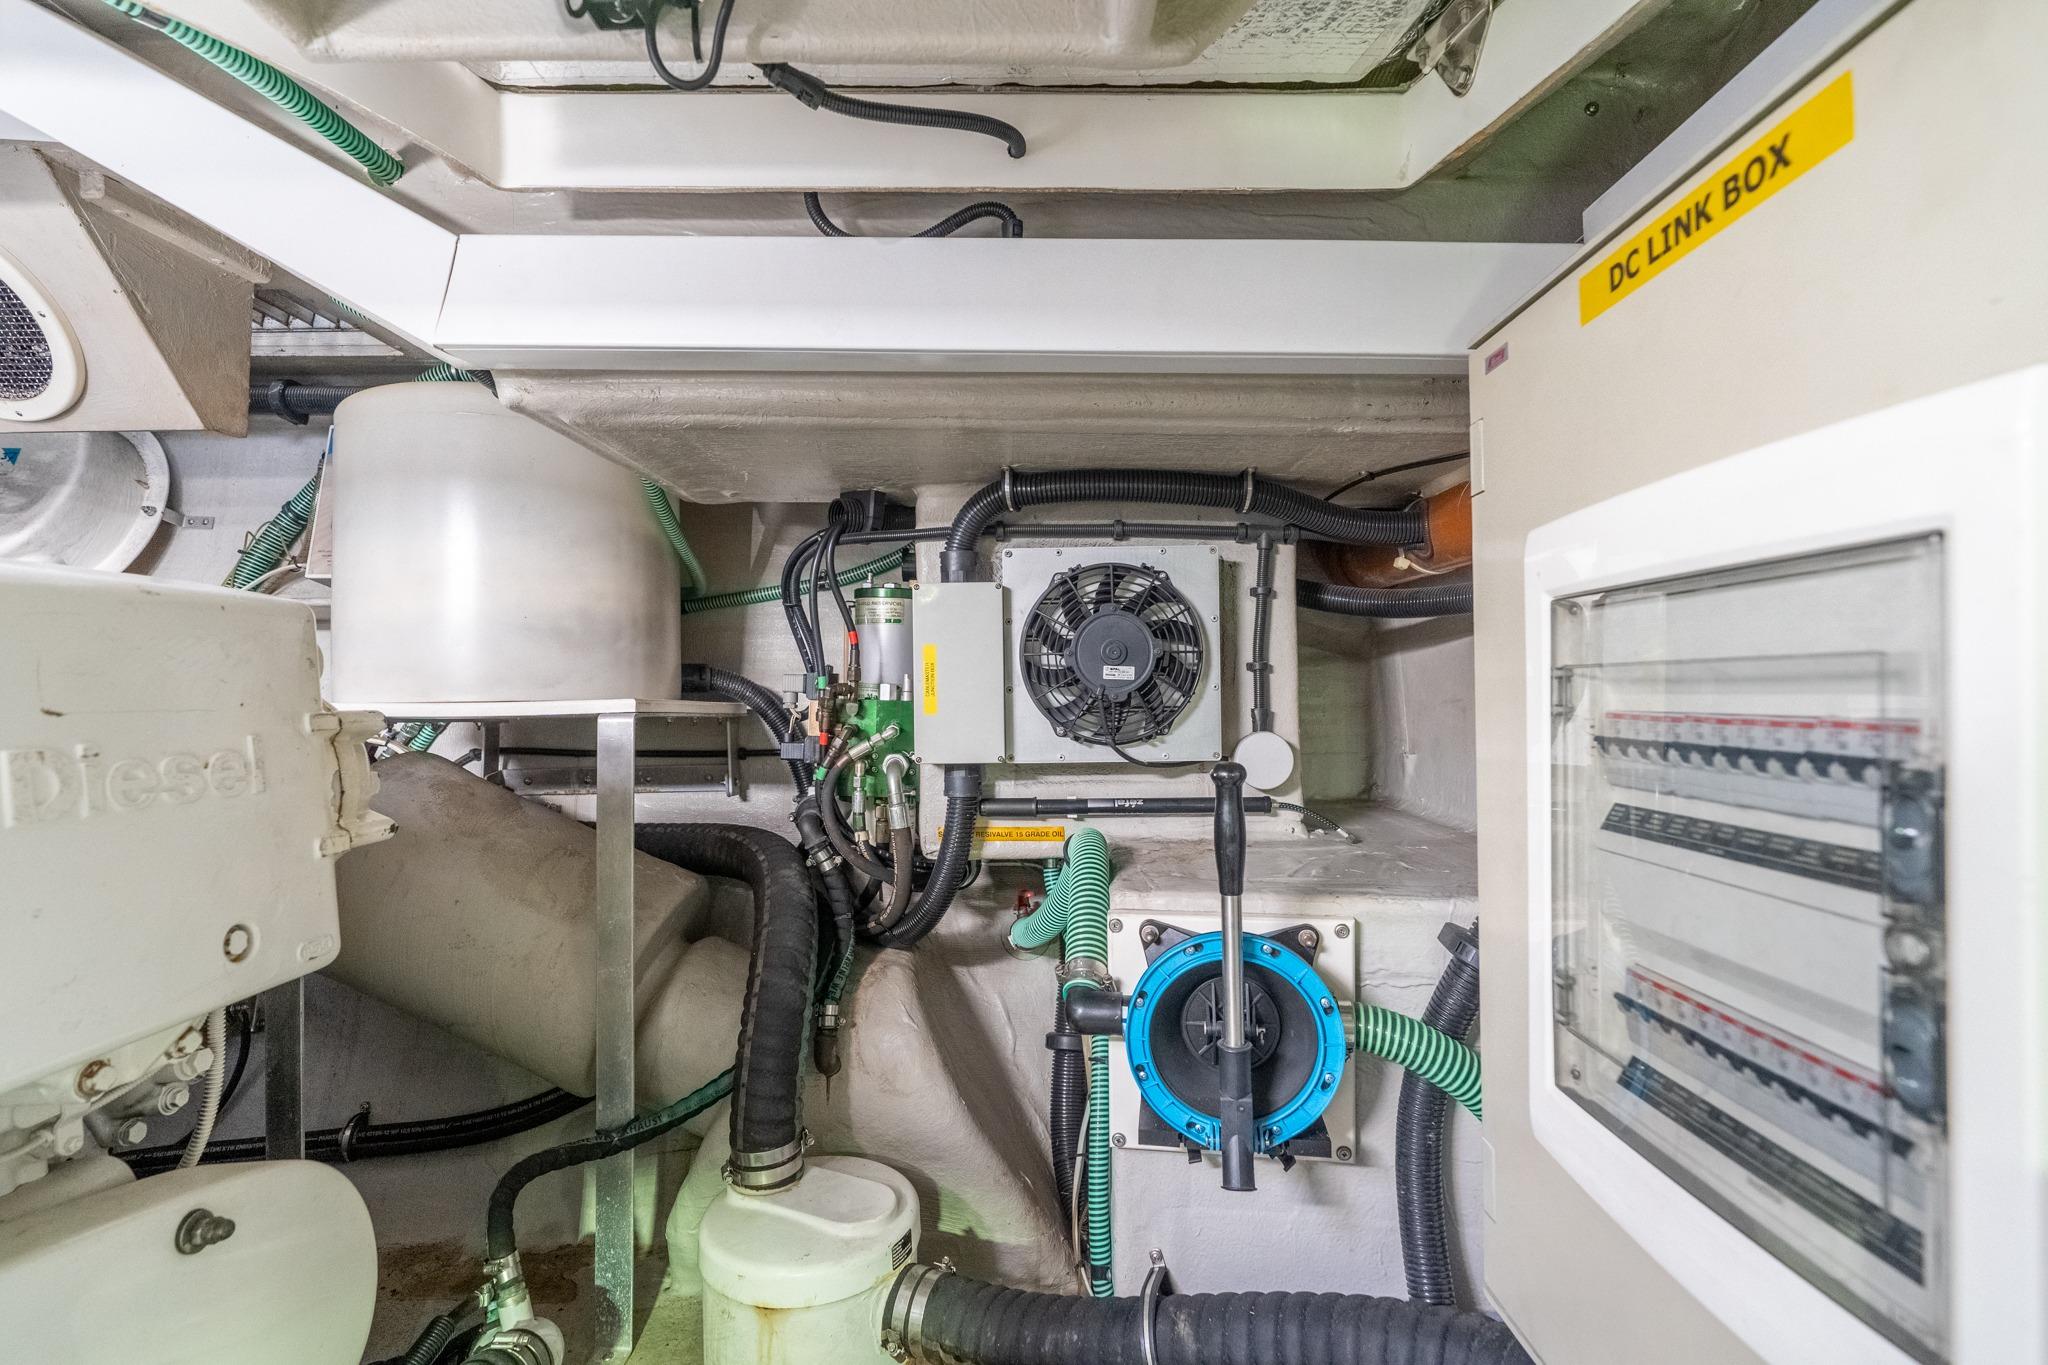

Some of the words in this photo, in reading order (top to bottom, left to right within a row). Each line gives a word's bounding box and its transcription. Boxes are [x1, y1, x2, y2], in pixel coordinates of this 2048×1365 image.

[1609, 248, 1641, 293] DC
[1647, 192, 1713, 266] LINK
[1723, 132, 1793, 211] BOX
[0, 734, 266, 828] Diesel
[1025, 829, 1049, 838] GRADE
[1052, 828, 1064, 838] OIL
